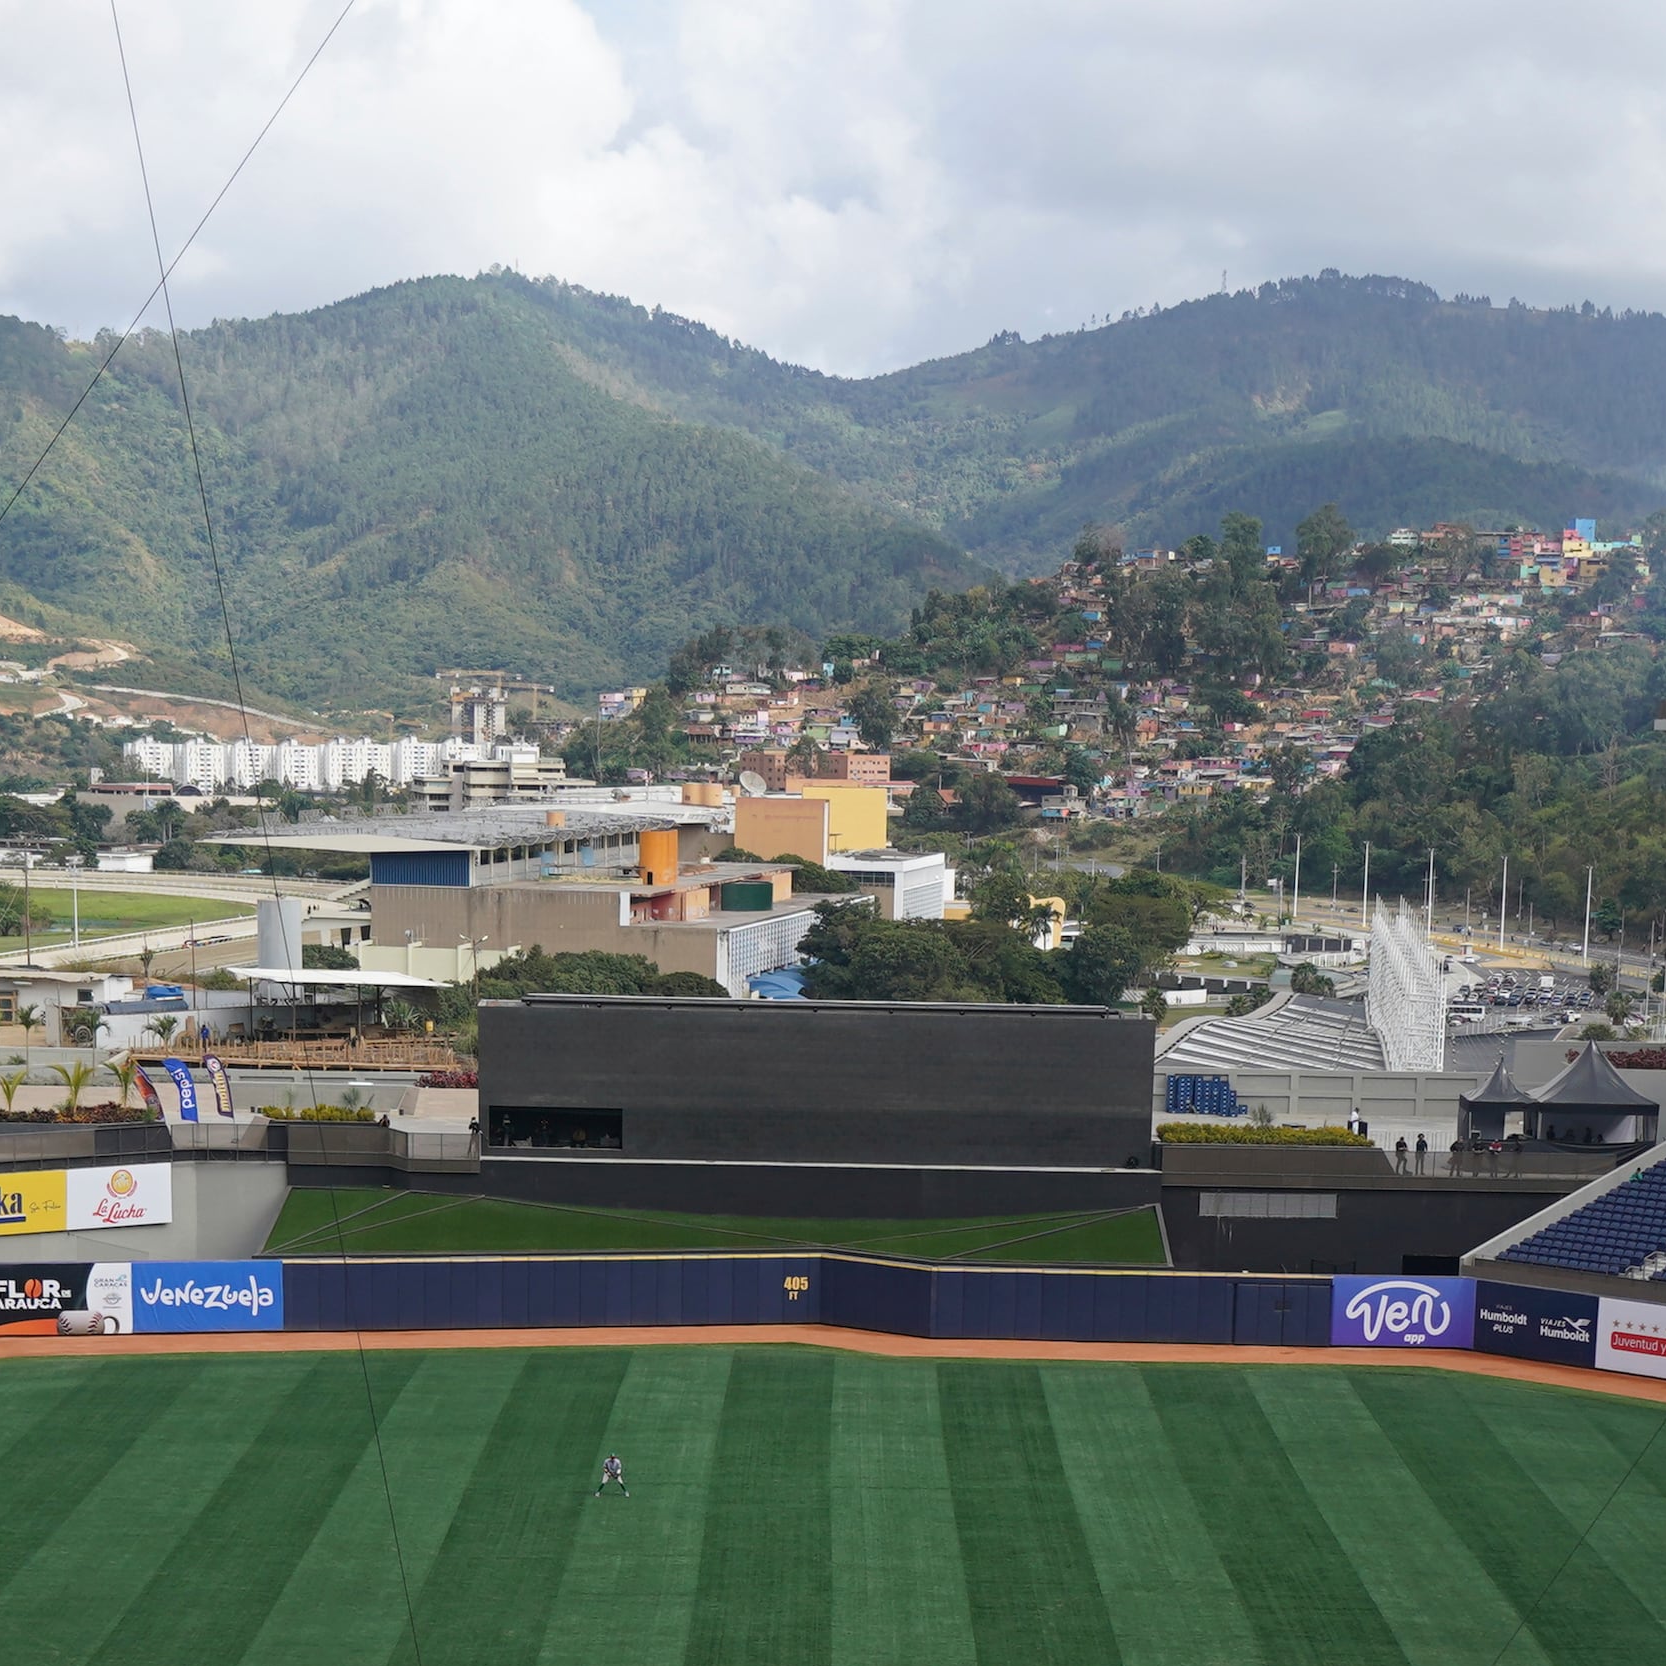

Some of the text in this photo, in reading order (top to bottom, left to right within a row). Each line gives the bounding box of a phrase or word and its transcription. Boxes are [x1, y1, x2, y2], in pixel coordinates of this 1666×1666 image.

[171, 1068, 195, 1109] pepsi
[92, 1199, 145, 1224] La Lucha
[783, 1275, 809, 1291] 405
[788, 1290, 799, 1301] FT
[1480, 1309, 1527, 1326] Humboldt
[1540, 1317, 1566, 1328] VIAJES
[1404, 1334, 1425, 1345] app
[1540, 1326, 1590, 1343] Humboldt
[1613, 1334, 1659, 1353] Juventud
[1660, 1343, 1666, 1354] y
